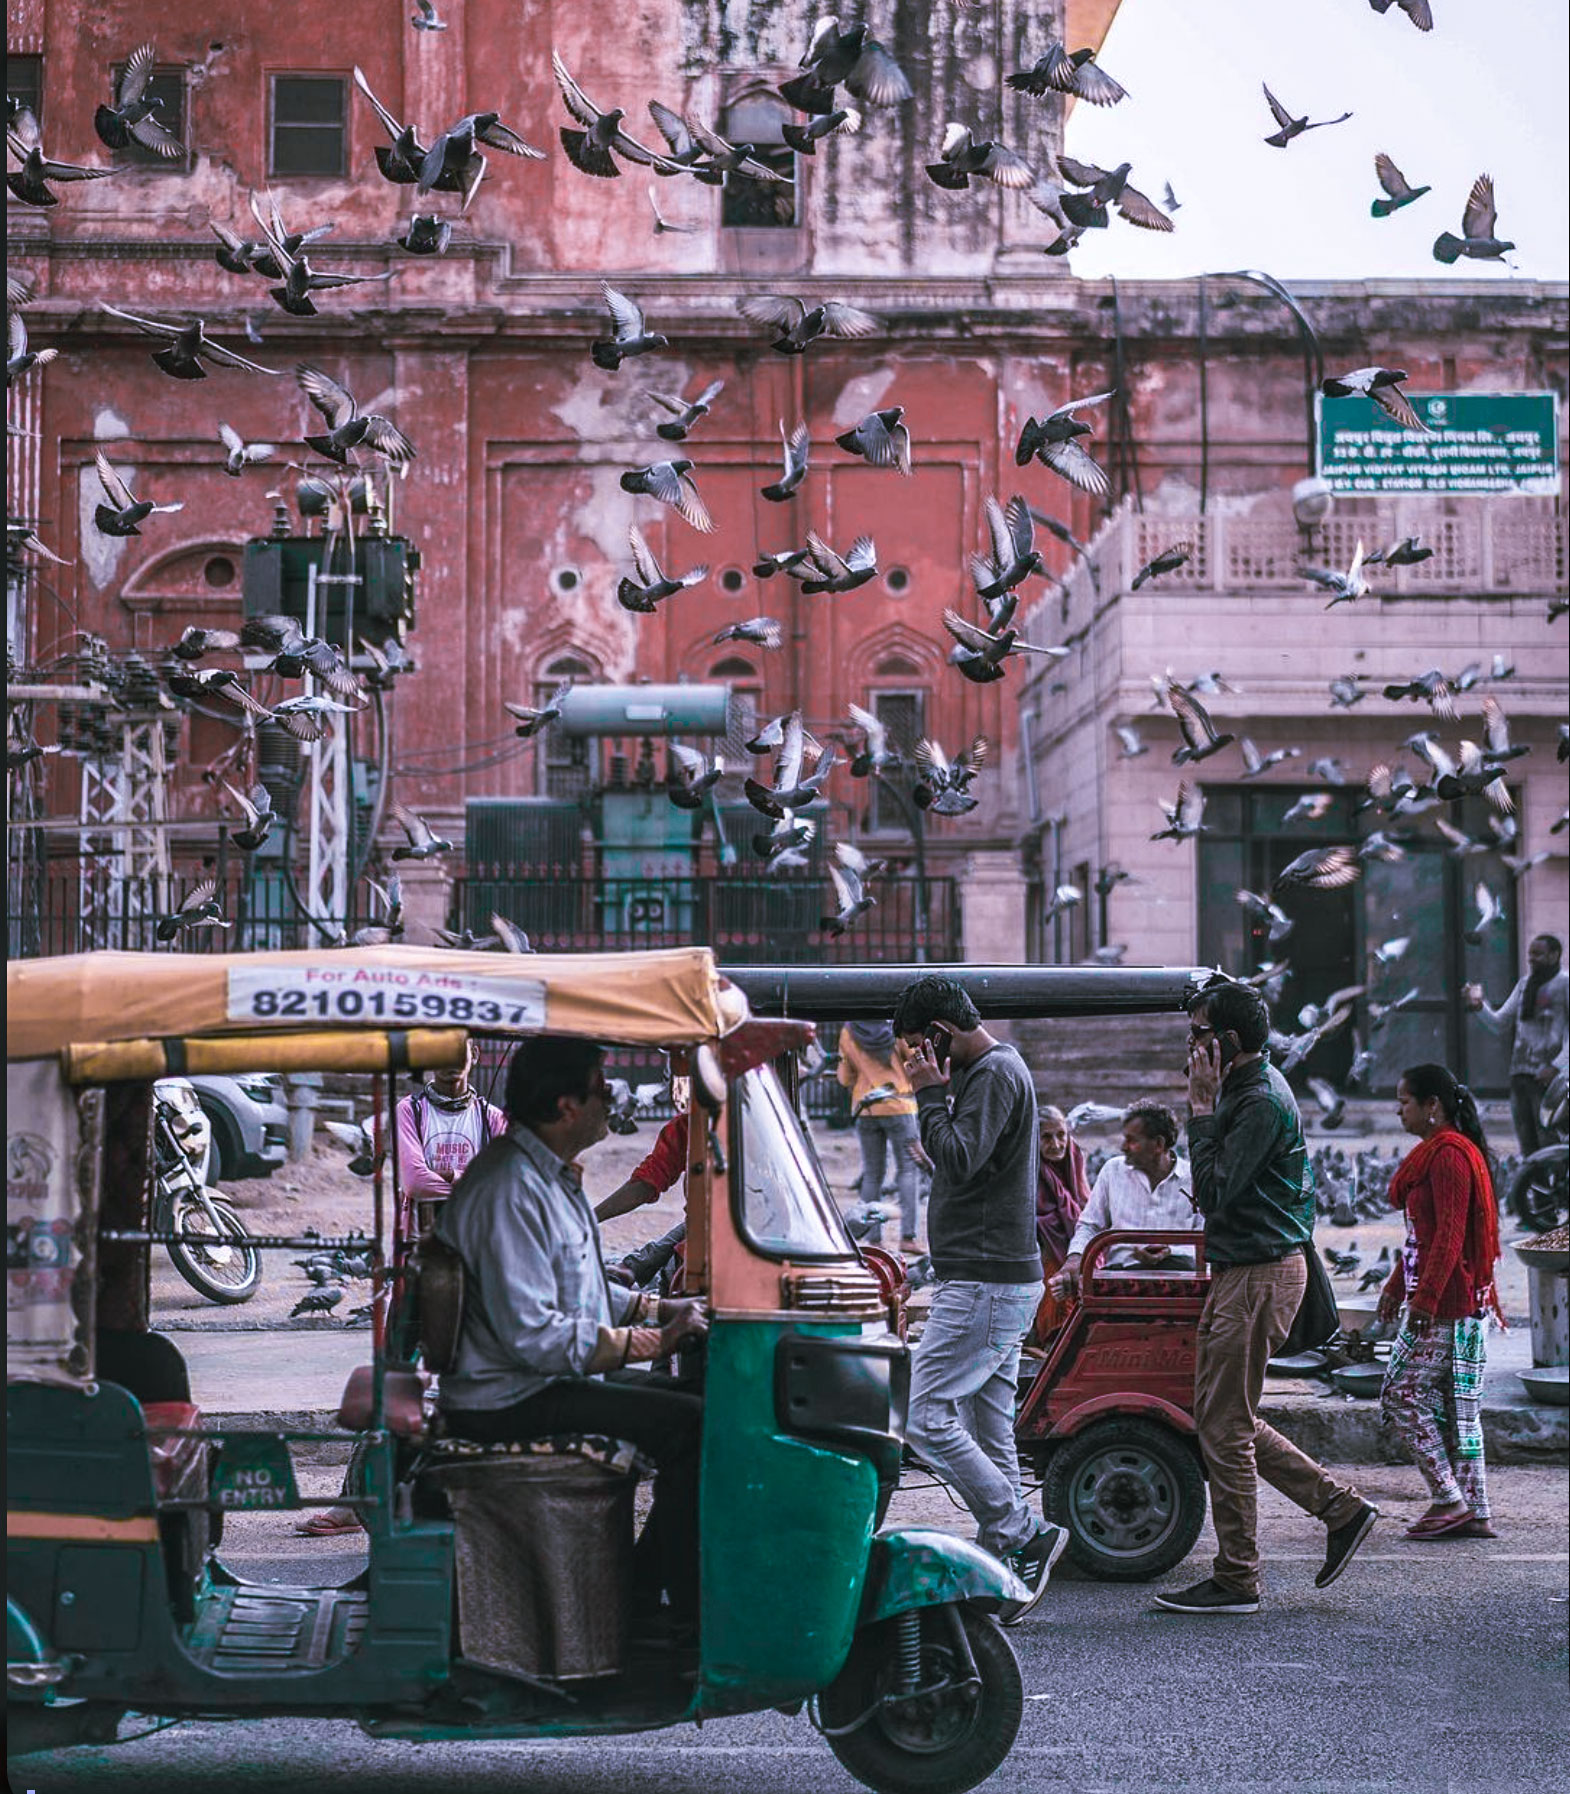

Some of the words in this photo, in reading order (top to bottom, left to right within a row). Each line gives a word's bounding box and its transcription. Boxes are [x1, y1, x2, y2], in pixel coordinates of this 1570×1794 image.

[306, 967, 345, 982] For
[353, 969, 409, 985] Auto
[416, 973, 463, 989] Ads
[252, 988, 528, 1024] 8210159837
[436, 1143, 469, 1154] MUSIC
[1157, 1346, 1194, 1368] Me
[236, 1468, 272, 1485] NO
[220, 1487, 287, 1506] ENTRY
